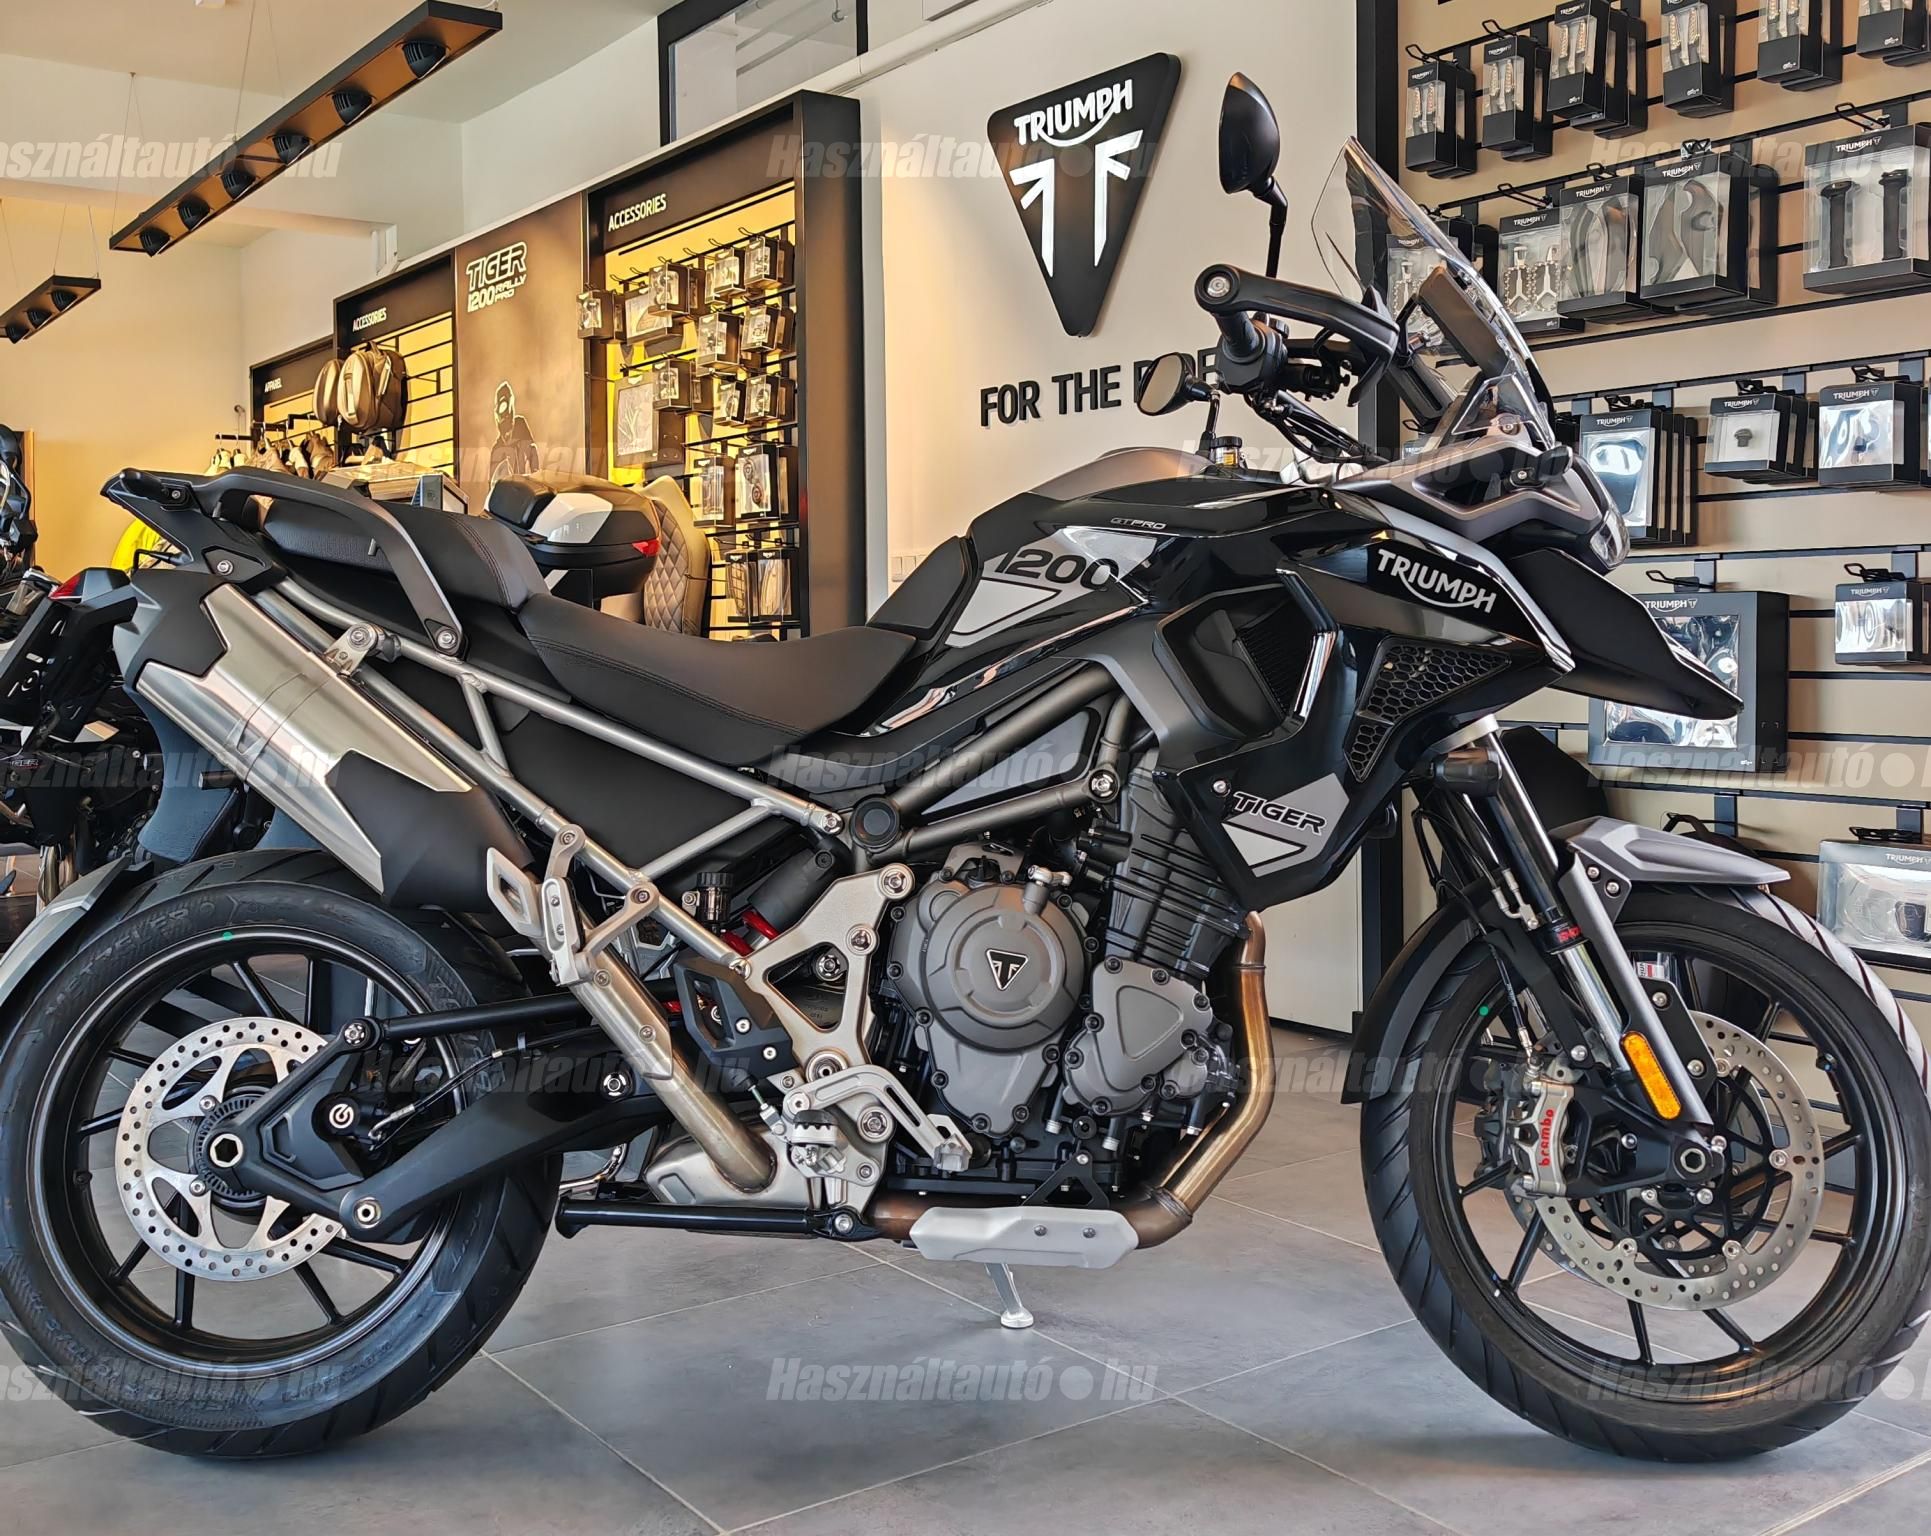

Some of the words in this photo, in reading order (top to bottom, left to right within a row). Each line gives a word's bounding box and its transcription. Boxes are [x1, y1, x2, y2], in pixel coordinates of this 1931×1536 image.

[1014, 79, 1133, 147] TRIUMPH
[1836, 138, 1873, 152] TRIUMPH
[1662, 164, 1695, 178] TRIUMPH
[1576, 185, 1605, 198] TRIUMPH
[608, 193, 667, 232] ACCESSORIES
[1513, 216, 1542, 227] TRIUMPH
[466, 241, 527, 292] TIGER
[467, 285, 496, 313] 1200
[353, 307, 388, 332] ACCESSORIES
[980, 380, 1041, 427] FOR
[1051, 365, 1122, 415] THE
[1724, 397, 1755, 409] TRIUMPH
[1833, 389, 1871, 401] TRIUMPH
[1596, 415, 1628, 427] TRIUMPH
[995, 549, 1119, 592] 1200
[1378, 548, 1497, 613] TRIUMPH
[1851, 588, 1882, 597] TRIUMPH
[1645, 600, 1688, 613] TRIUMPH
[1233, 791, 1327, 836] TIGER
[1885, 853, 1923, 865] TRIUMPH
[1538, 1109, 1554, 1167] brembo
